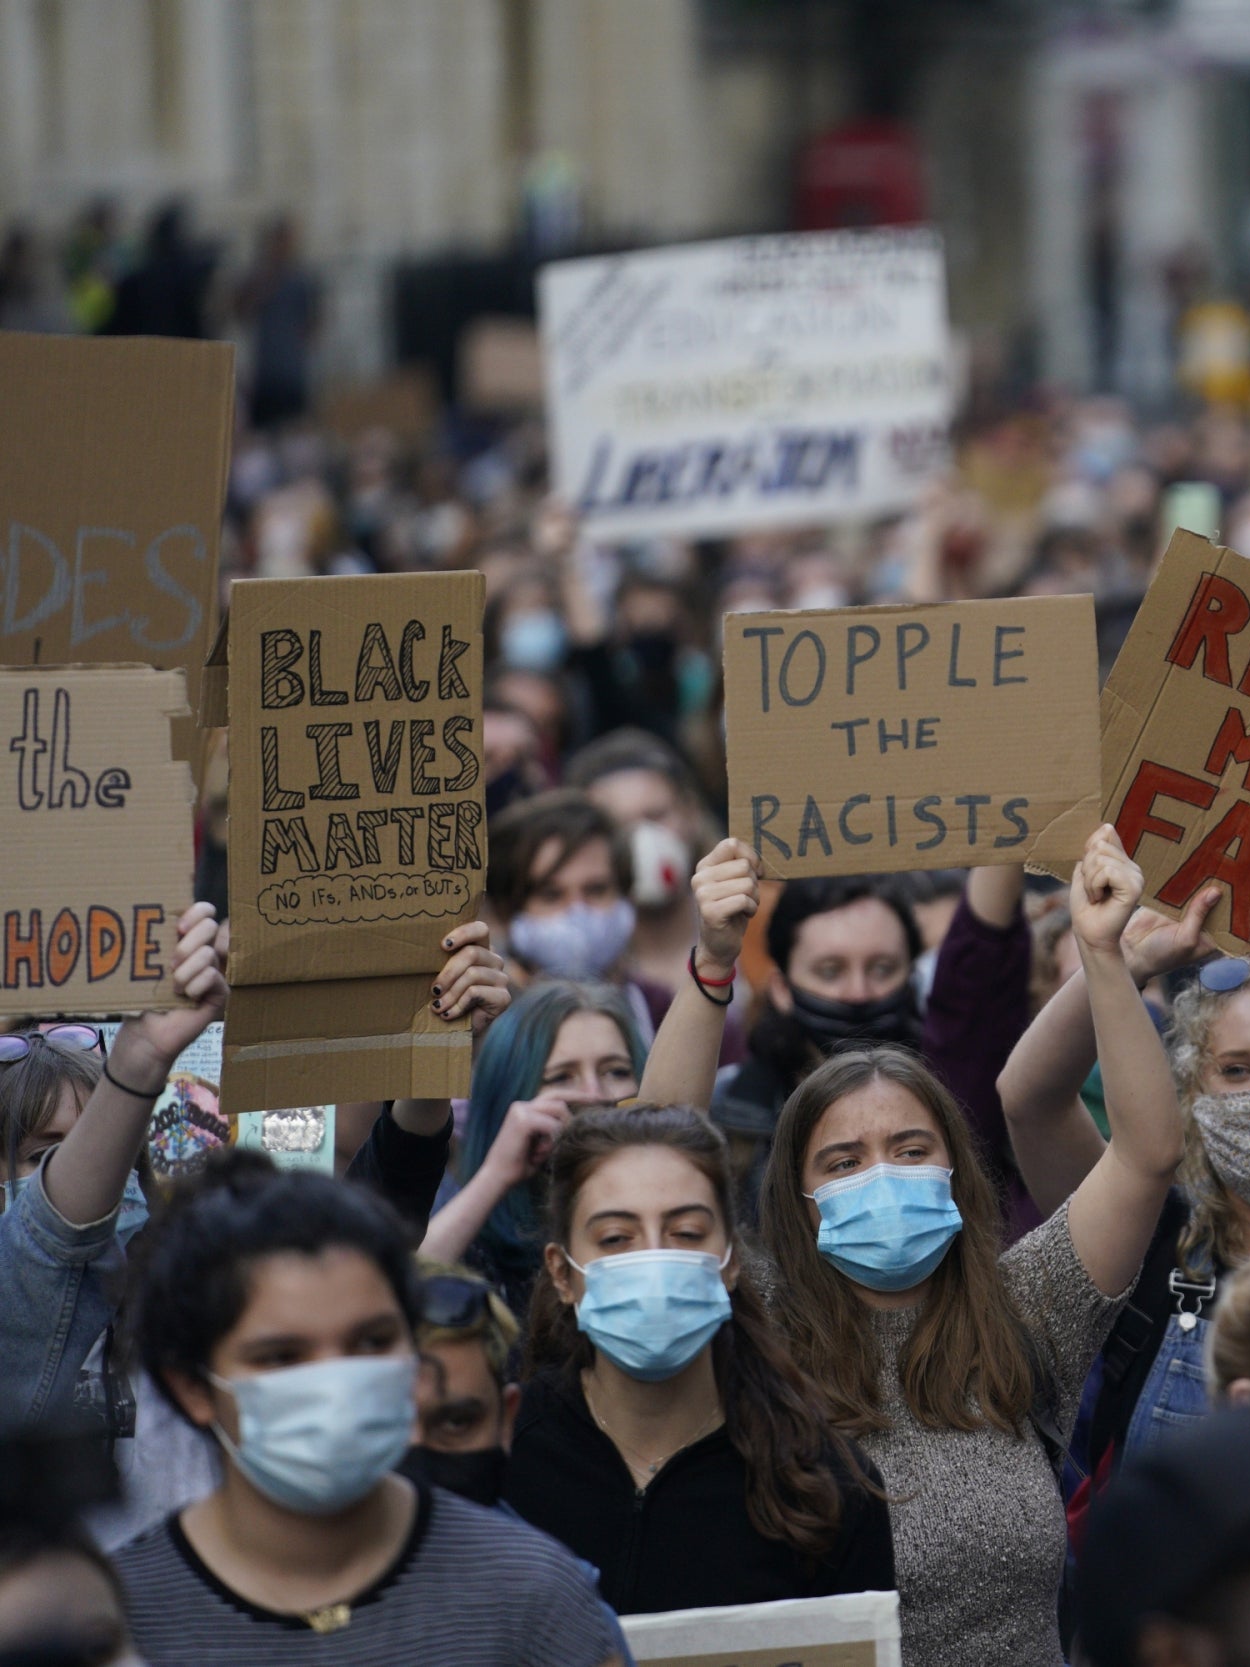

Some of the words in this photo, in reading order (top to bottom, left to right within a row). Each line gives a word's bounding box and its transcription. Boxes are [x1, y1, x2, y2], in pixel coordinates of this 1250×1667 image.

[0, 520, 207, 650] DES
[743, 622, 1030, 713] TOPPLE
[9, 687, 132, 811] the
[260, 715, 480, 812] LIVES
[831, 717, 941, 757] THE
[260, 800, 483, 875] MATTER
[750, 793, 1030, 861] RACISTS
[275, 891, 301, 911] NO
[405, 885, 419, 897] or
[0, 903, 165, 989] HODE
